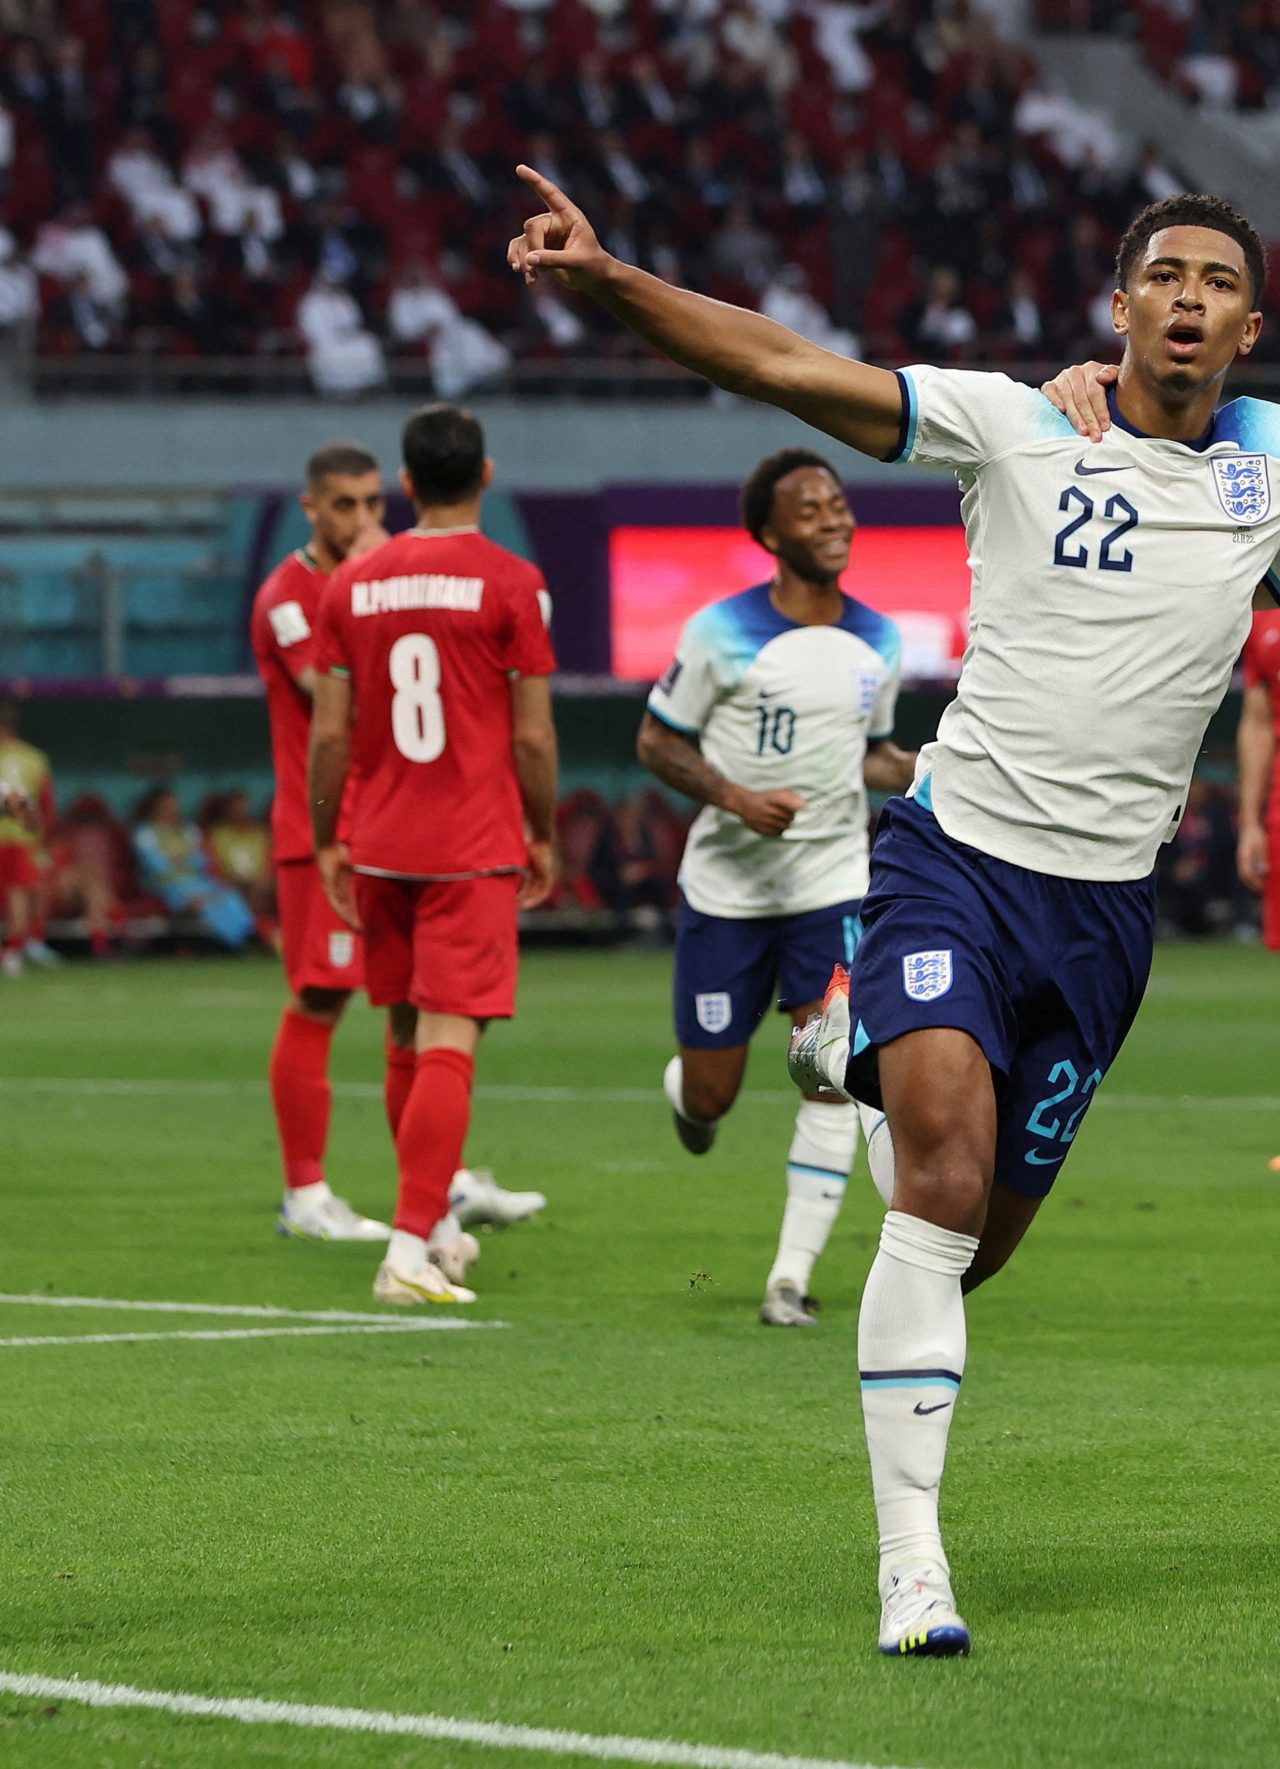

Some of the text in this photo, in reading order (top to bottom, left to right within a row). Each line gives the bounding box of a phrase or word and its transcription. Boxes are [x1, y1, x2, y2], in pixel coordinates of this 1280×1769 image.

[1054, 485, 1139, 572] 22
[389, 632, 447, 763] 8
[756, 705, 797, 757] 10
[1025, 1059, 1103, 1142] 22
